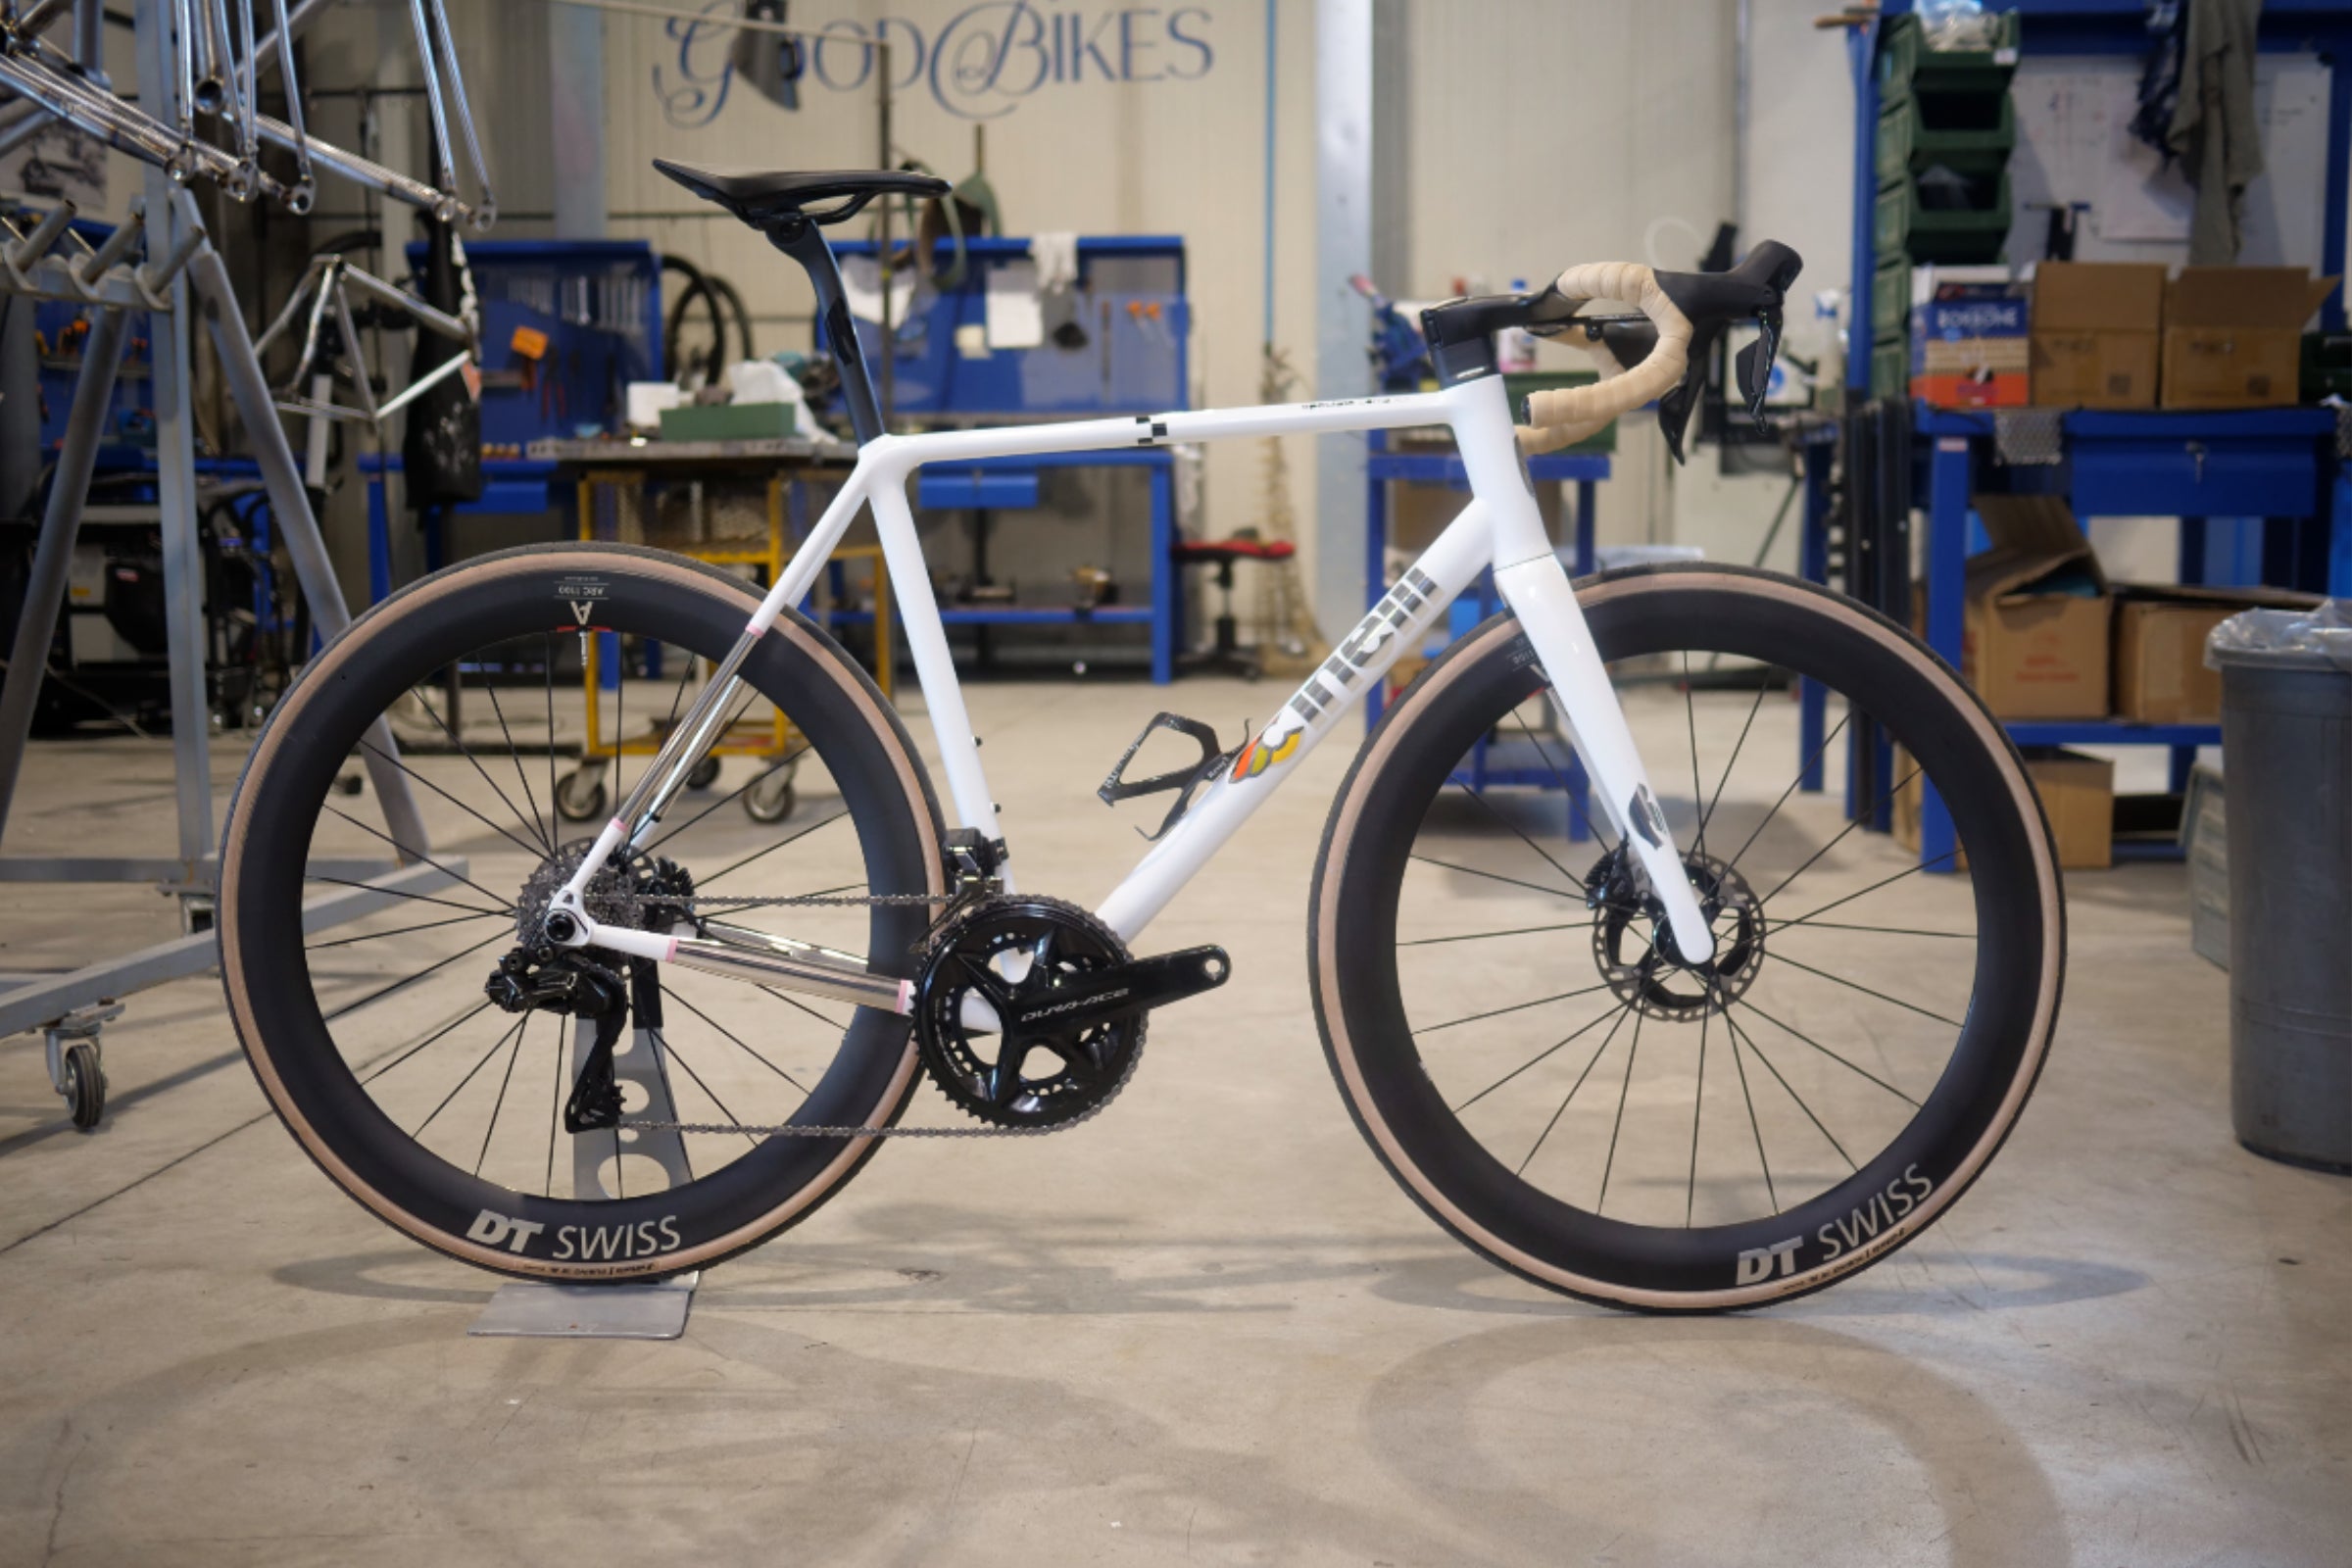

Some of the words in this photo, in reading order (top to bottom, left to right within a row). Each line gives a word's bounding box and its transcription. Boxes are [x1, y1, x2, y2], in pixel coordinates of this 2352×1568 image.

[1020, 988, 1130, 1022] DURA-ACE
[466, 1208, 545, 1253] DT
[552, 1215, 681, 1260] SWISS
[1736, 1235, 1804, 1287] DT
[1818, 1162, 1934, 1261] SWISS
